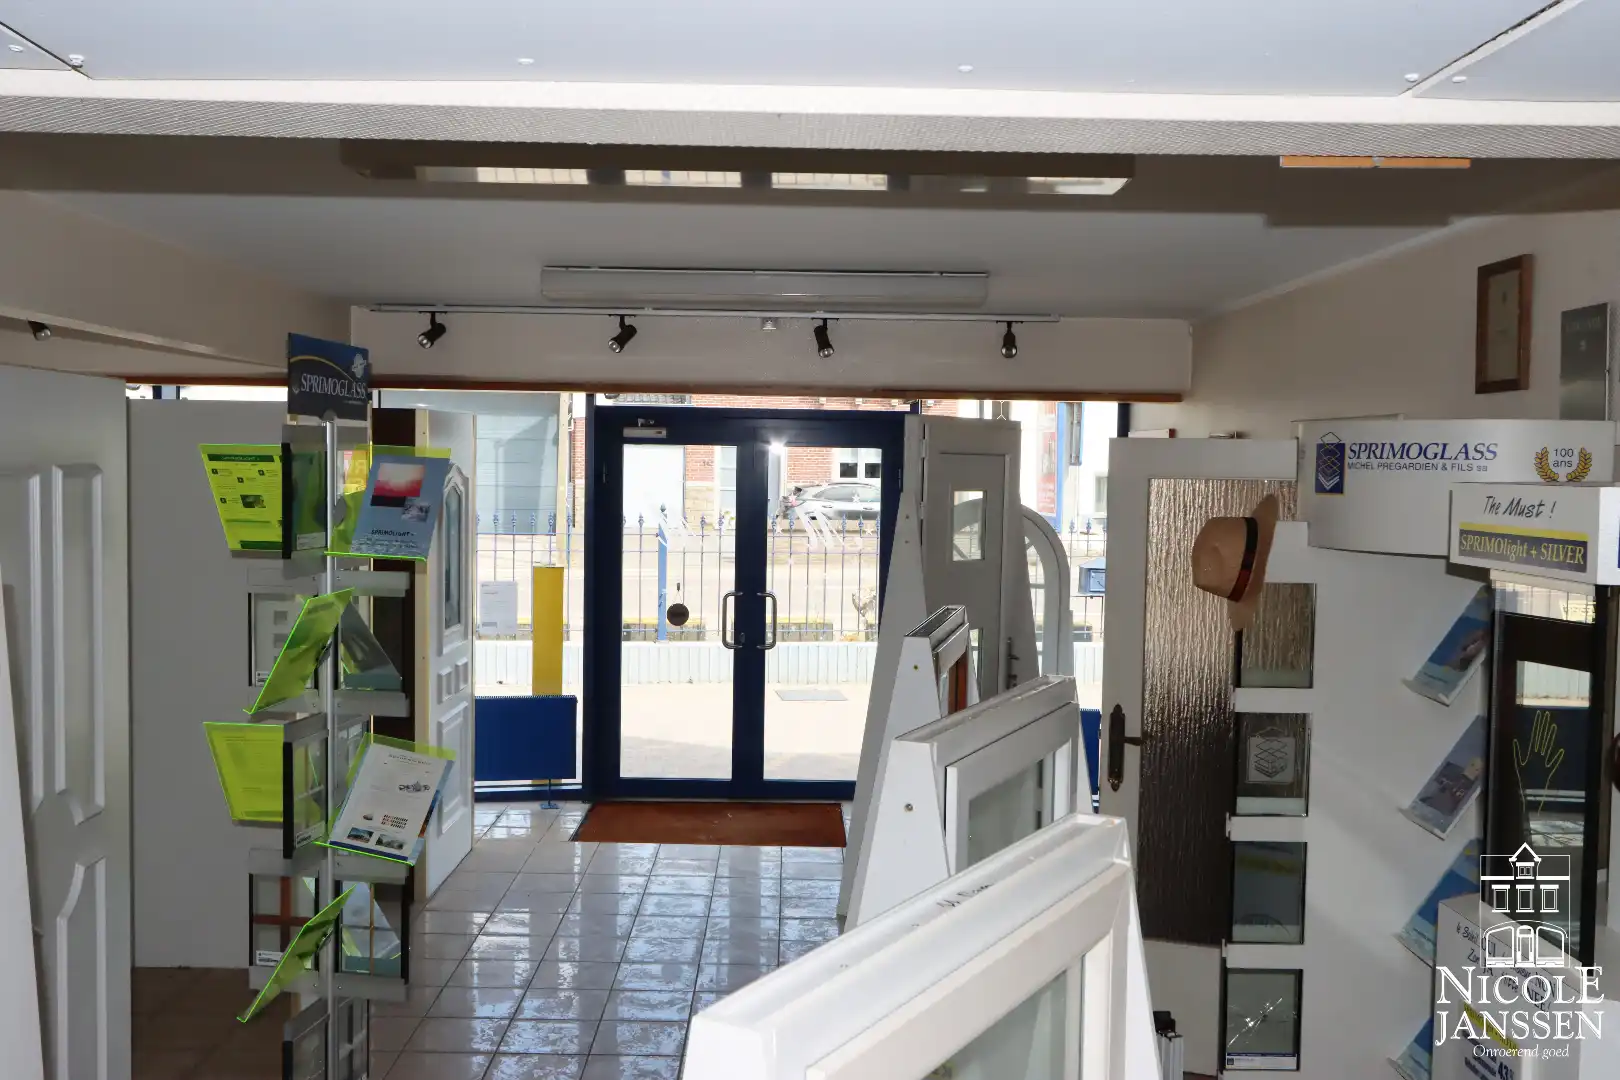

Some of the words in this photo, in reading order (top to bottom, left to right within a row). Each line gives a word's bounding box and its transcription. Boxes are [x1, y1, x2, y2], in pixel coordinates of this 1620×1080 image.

[300, 373, 366, 399] SPRIMOGLASS
[1347, 442, 1498, 462] SPRIMOGLASS
[1552, 448, 1574, 458] 100
[1347, 462, 1376, 471] MICHEL
[1377, 462, 1440, 472] PREGARDIEN
[1441, 463, 1448, 472] &
[1451, 463, 1474, 472] FILS
[1552, 459, 1573, 468] ans
[1483, 496, 1501, 516] The
[1503, 498, 1545, 519] Must
[1549, 501, 1556, 519] !
[1461, 533, 1527, 562] SPRIMOlight
[1530, 547, 1538, 557] +
[1541, 542, 1584, 565] SILVER
